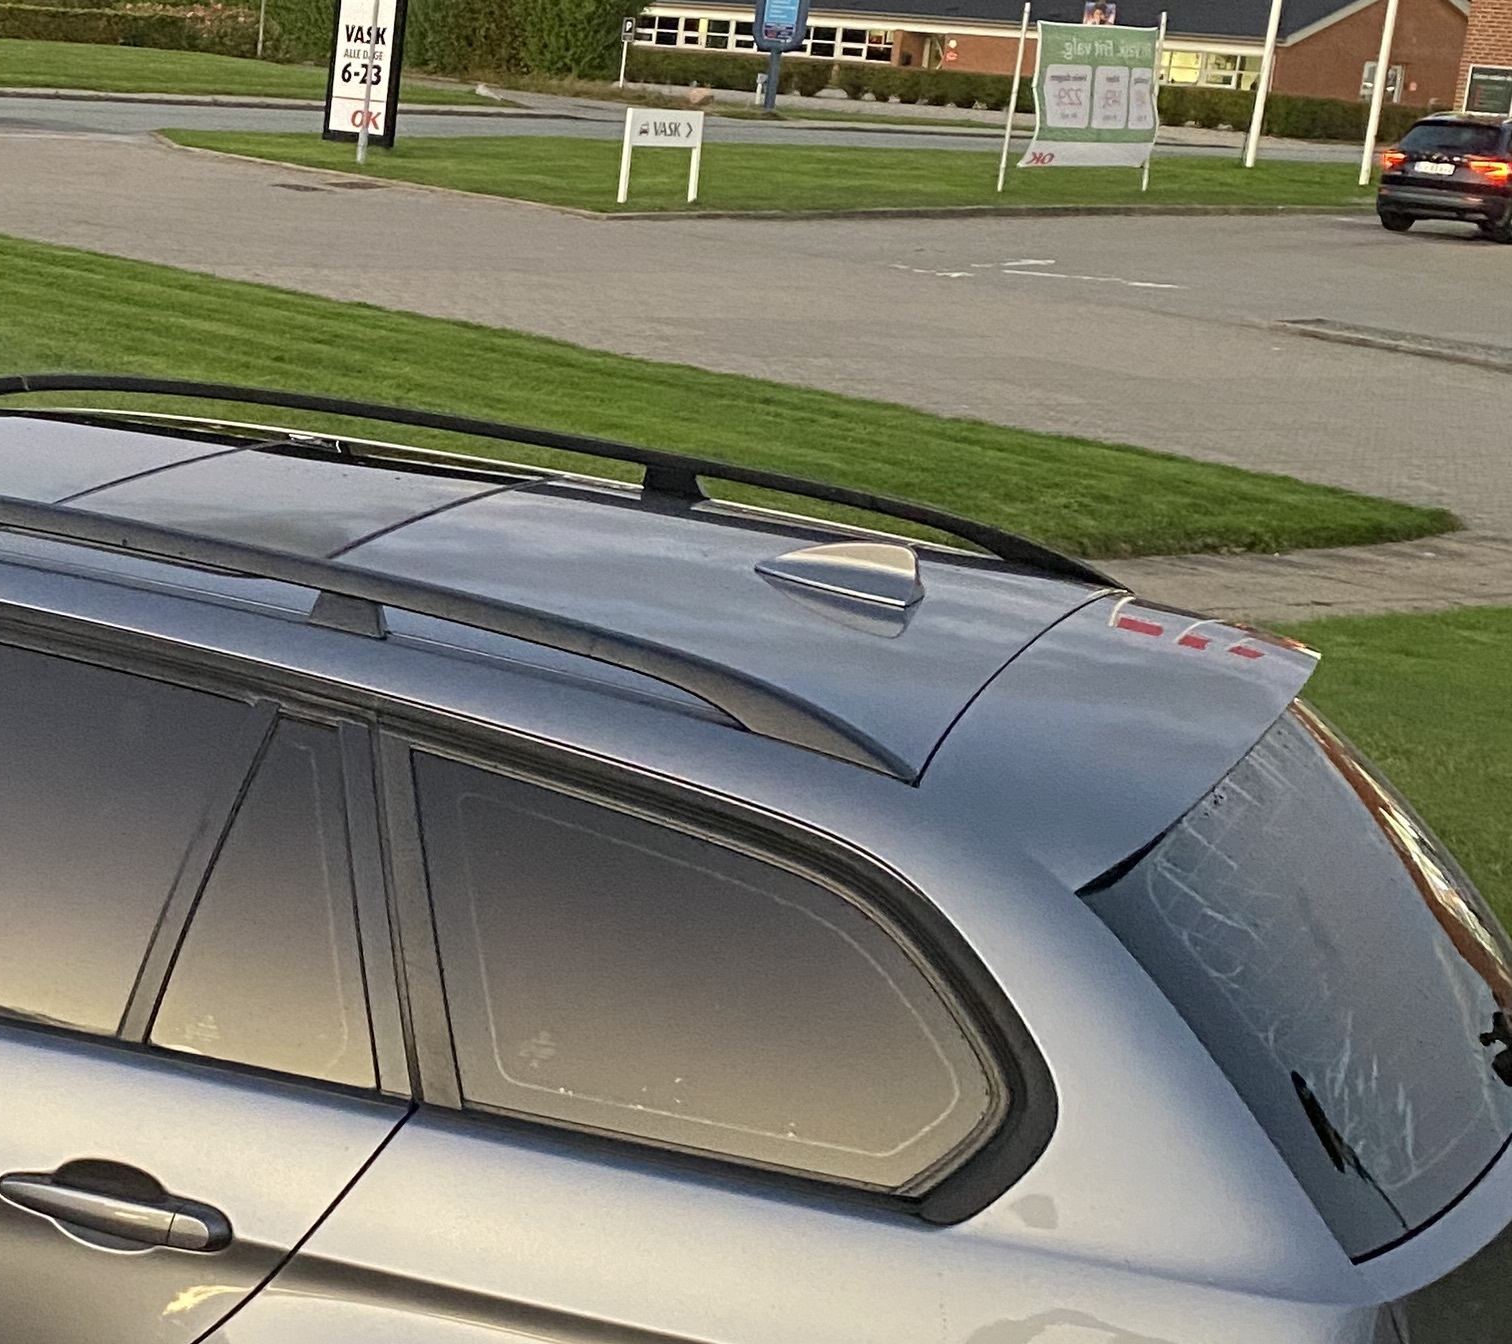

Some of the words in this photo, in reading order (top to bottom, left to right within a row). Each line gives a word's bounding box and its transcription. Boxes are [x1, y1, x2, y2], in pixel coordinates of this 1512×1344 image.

[345, 24, 387, 45] VASK
[625, 21, 633, 32] P
[343, 48, 361, 60] ALLE
[363, 50, 384, 61] DGE
[341, 62, 382, 86] 6-23
[351, 109, 382, 130] OK
[653, 121, 681, 137] VASK
